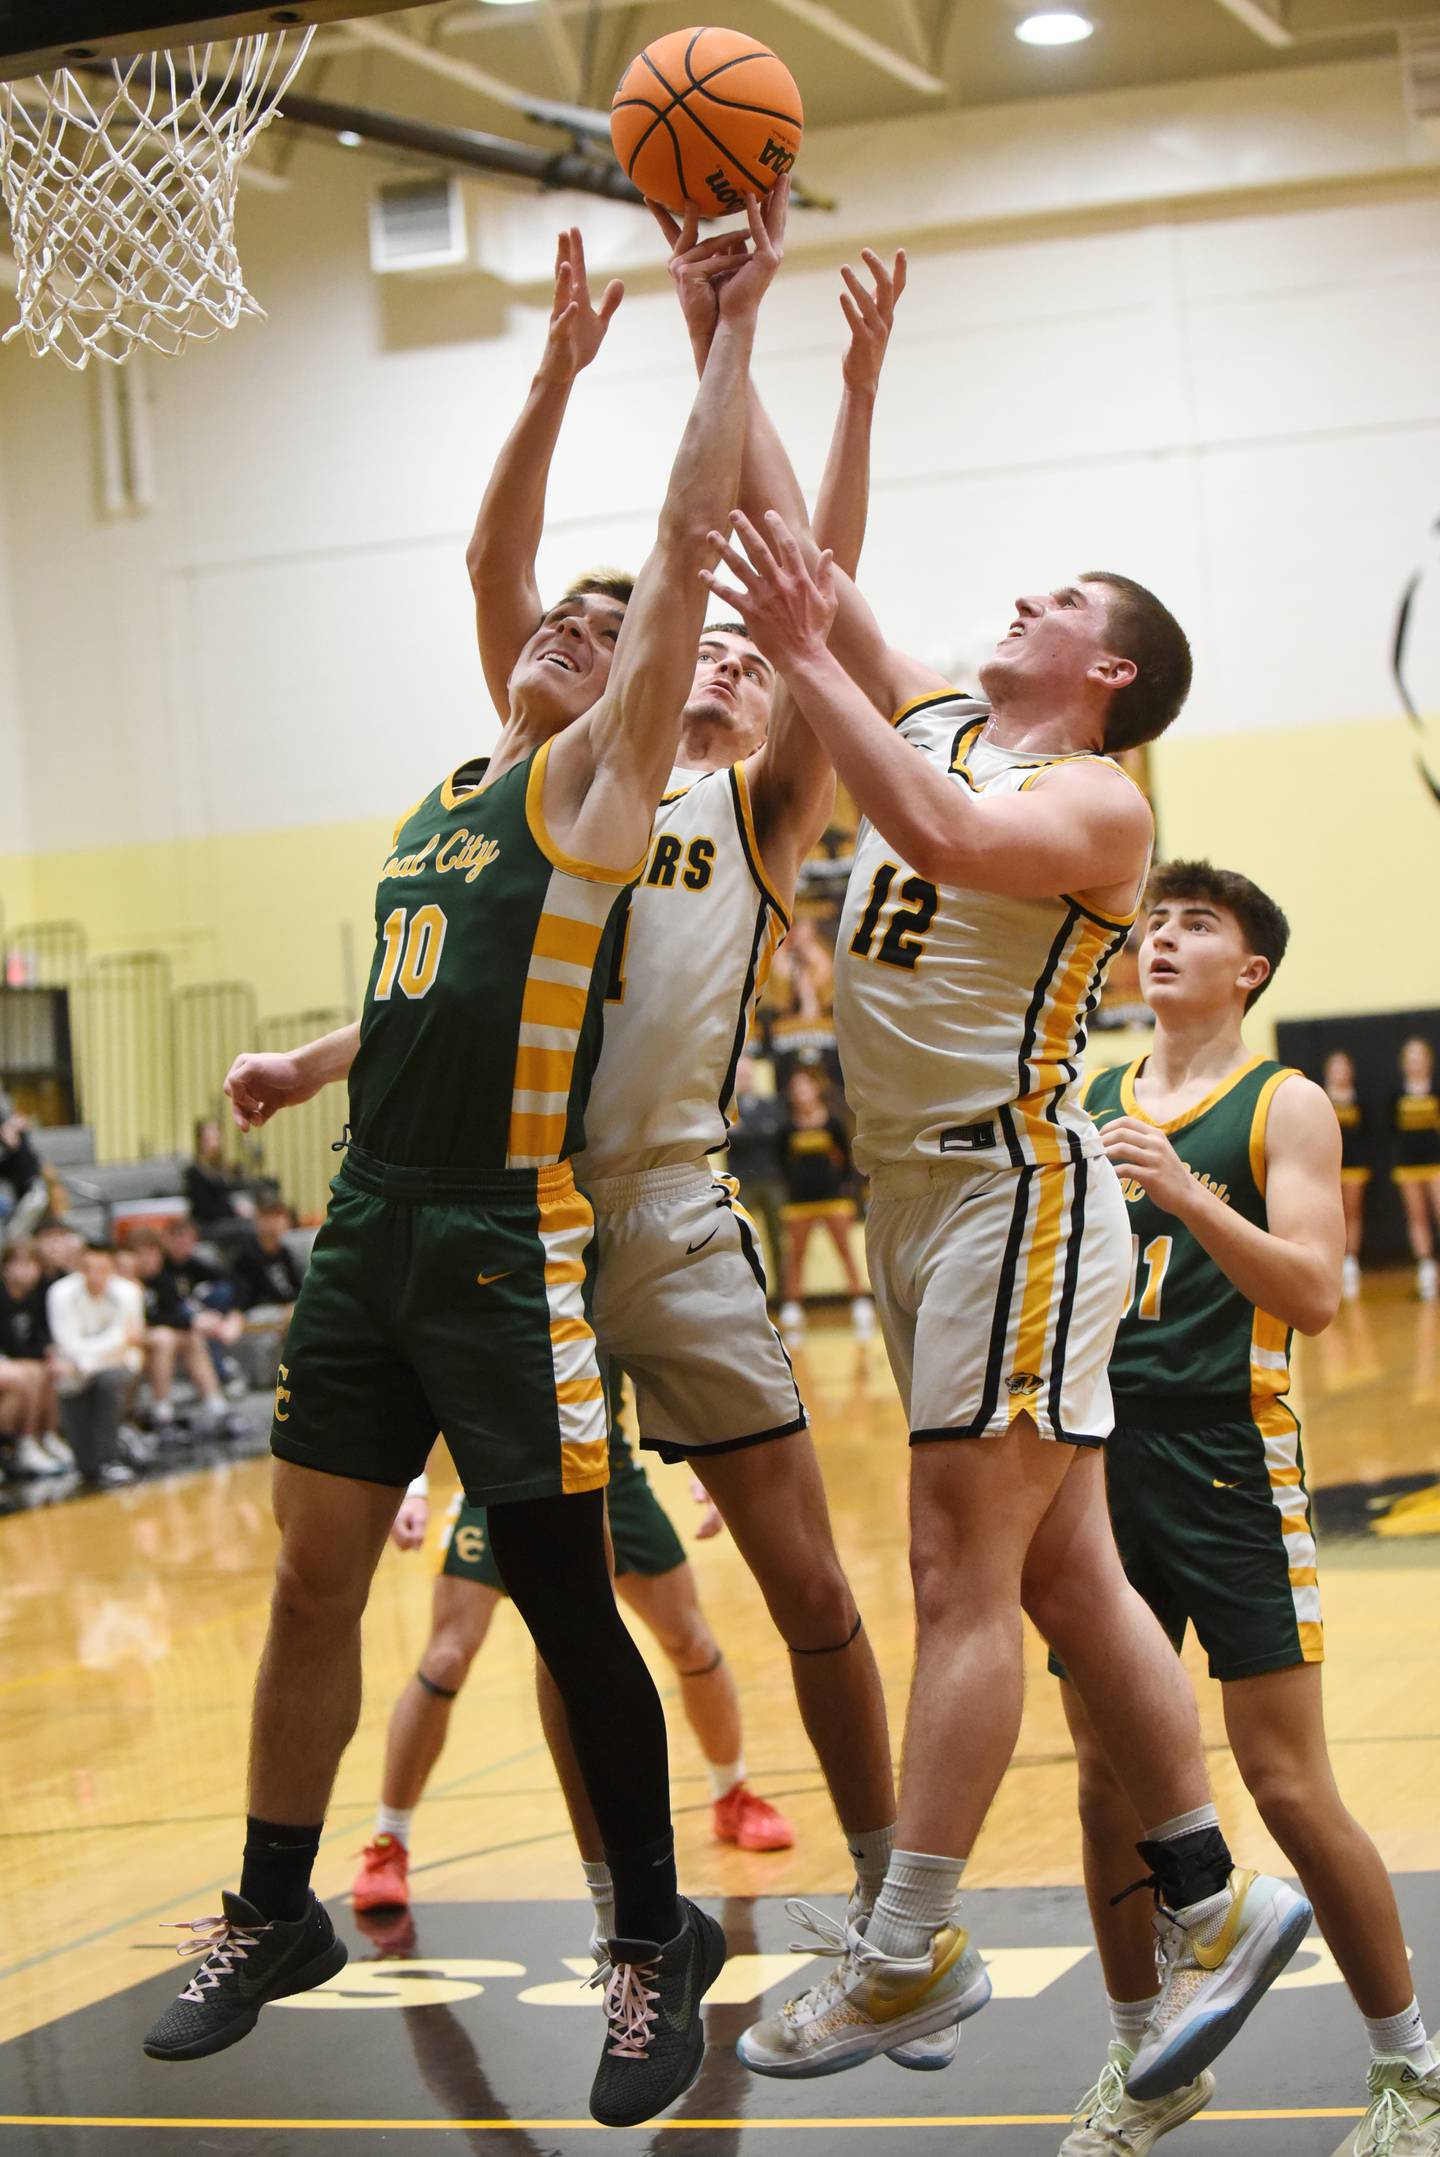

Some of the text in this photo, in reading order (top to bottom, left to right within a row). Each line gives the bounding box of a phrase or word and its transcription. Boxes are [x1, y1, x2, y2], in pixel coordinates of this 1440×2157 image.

[436, 828, 500, 883] City
[374, 904, 448, 1000] 10
[848, 860, 940, 972] 12
